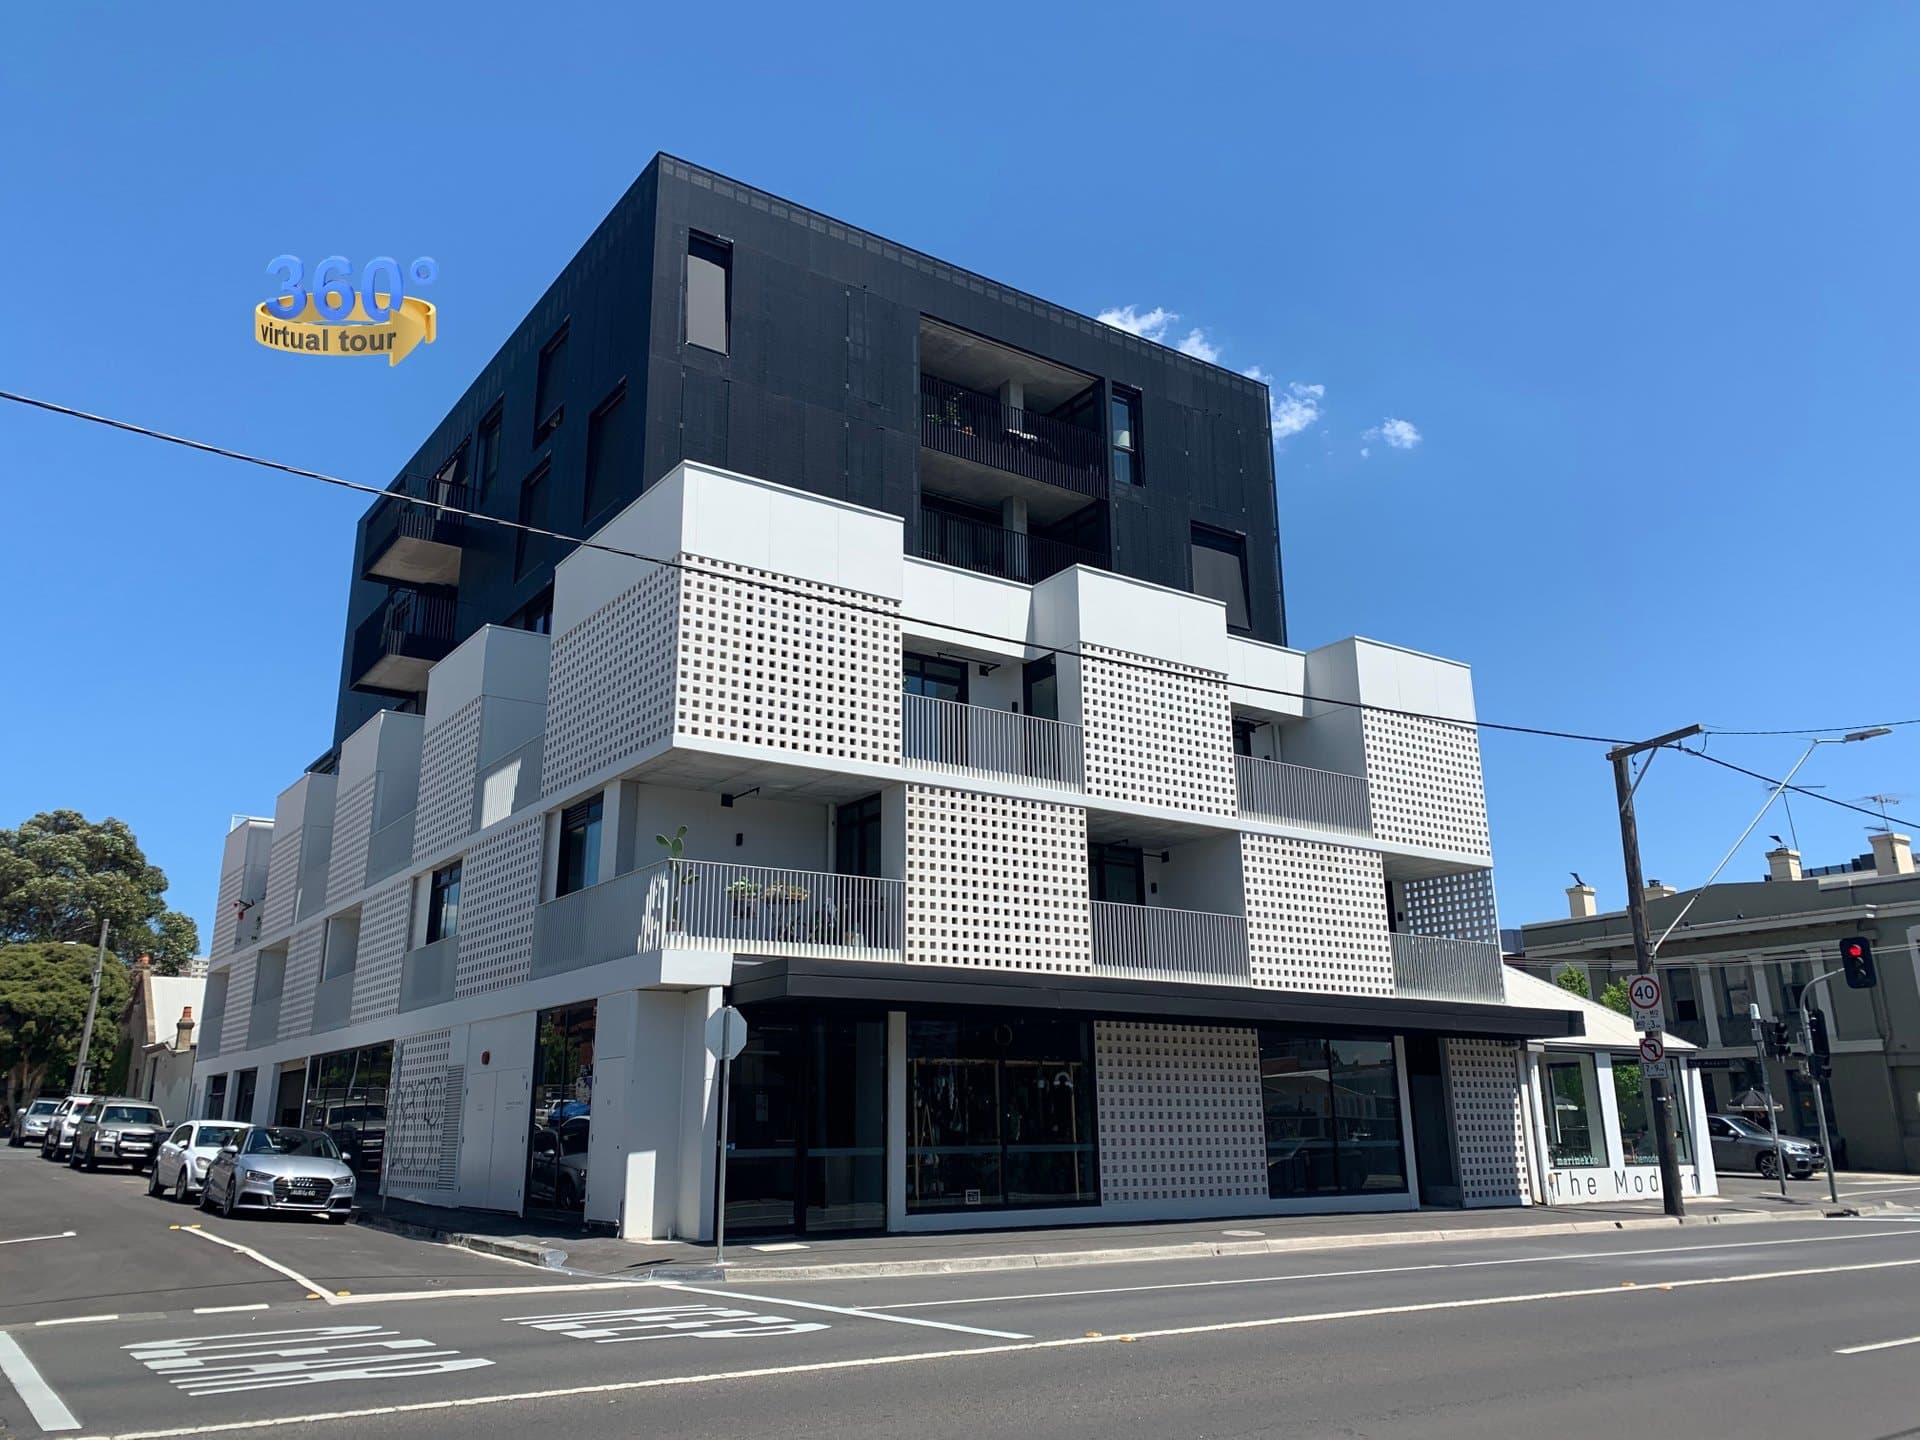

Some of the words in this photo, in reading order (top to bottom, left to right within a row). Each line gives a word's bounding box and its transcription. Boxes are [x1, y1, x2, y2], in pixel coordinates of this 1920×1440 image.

[1634, 985, 1654, 1000] 40
[1556, 1154, 1599, 1166] marimekko
[1553, 1170, 1597, 1197] The
[1614, 1168, 1700, 1194] Modrn
[501, 1304, 833, 1343] KEEP
[119, 1325, 496, 1396] CLEAR
